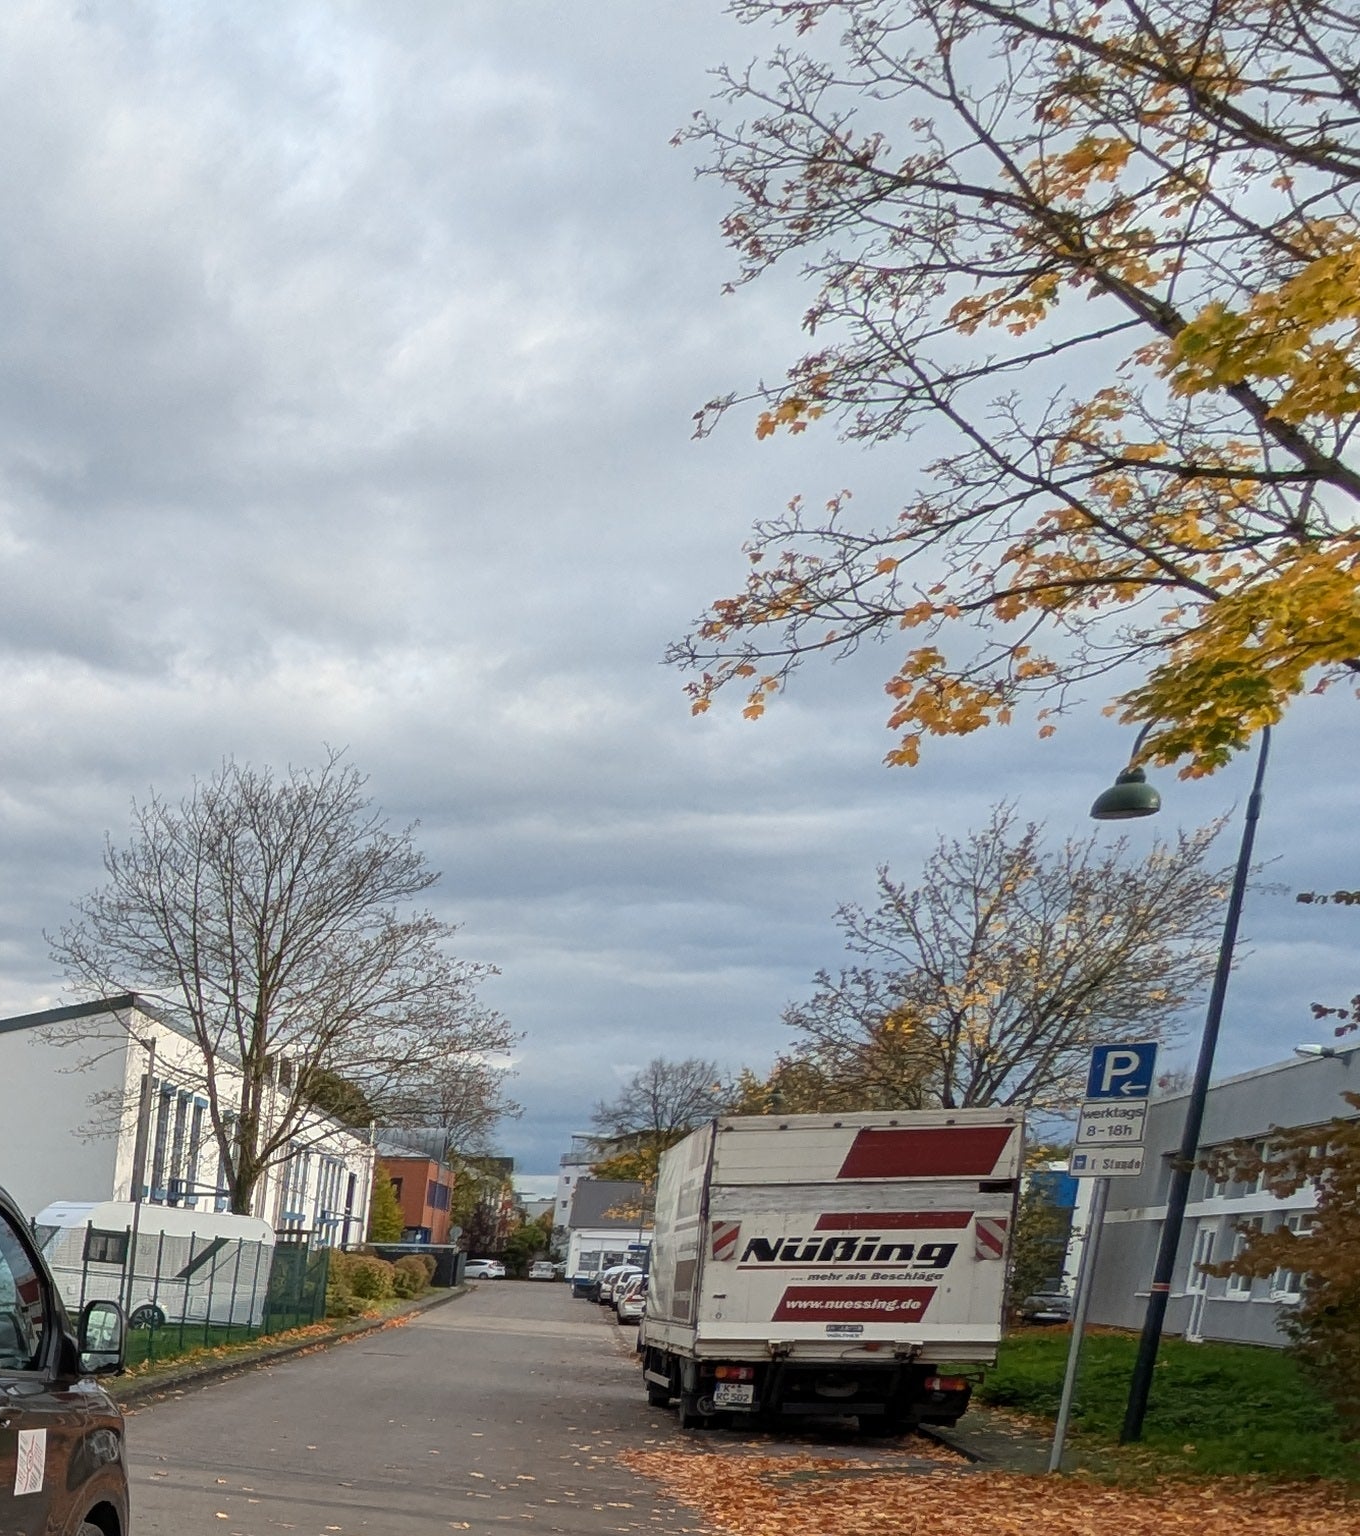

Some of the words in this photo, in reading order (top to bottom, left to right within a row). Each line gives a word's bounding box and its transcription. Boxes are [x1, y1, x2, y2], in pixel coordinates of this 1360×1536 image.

[1100, 1051, 1140, 1092] P
[1083, 1107, 1144, 1120] werktags
[740, 1236, 958, 1269] Nüßing
[807, 1272, 842, 1281] mehr
[846, 1272, 866, 1281] als
[785, 1299, 922, 1312] www.nuessing.de
